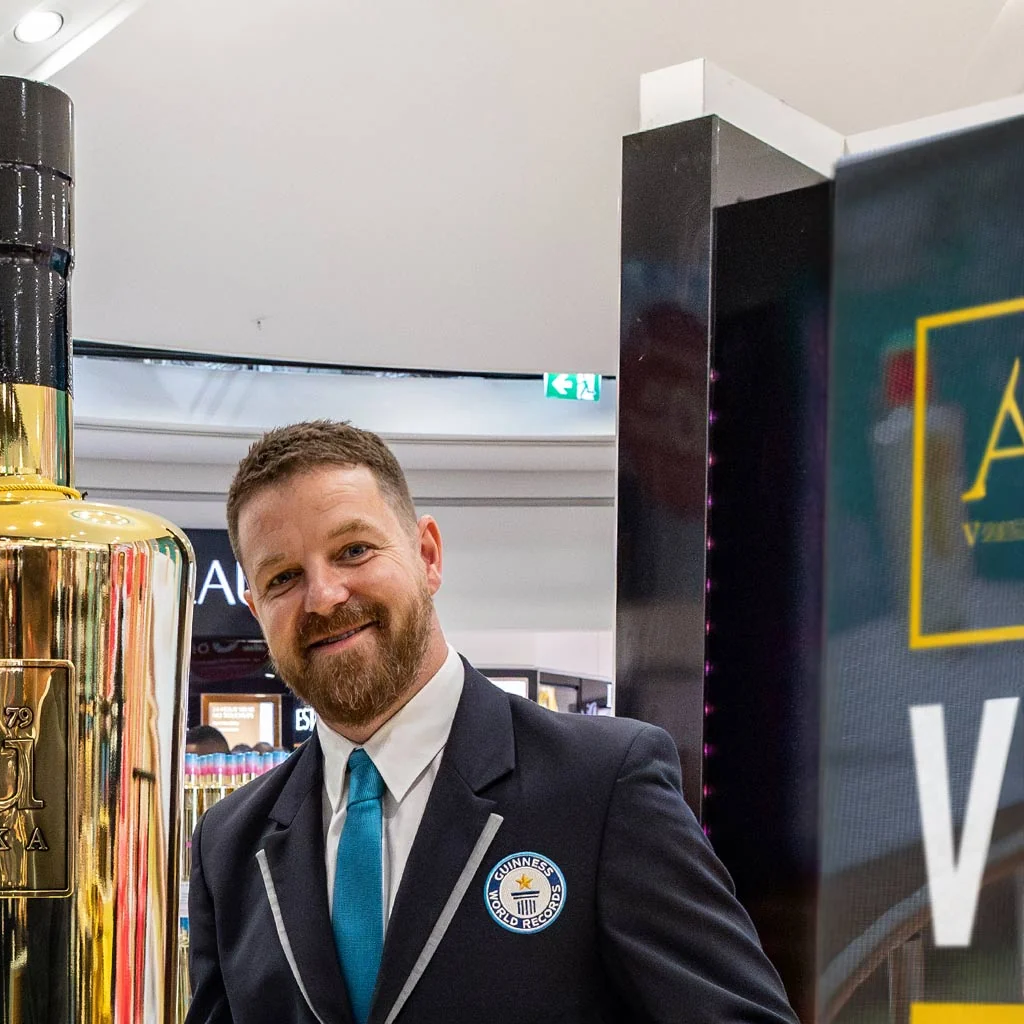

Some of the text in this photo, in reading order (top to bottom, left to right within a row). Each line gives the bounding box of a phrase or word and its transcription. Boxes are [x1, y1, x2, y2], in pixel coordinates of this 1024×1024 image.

[4, 705, 34, 730] 79
[494, 857, 554, 881] GUINNESS
[488, 884, 561, 929] WORLD RECORDS
